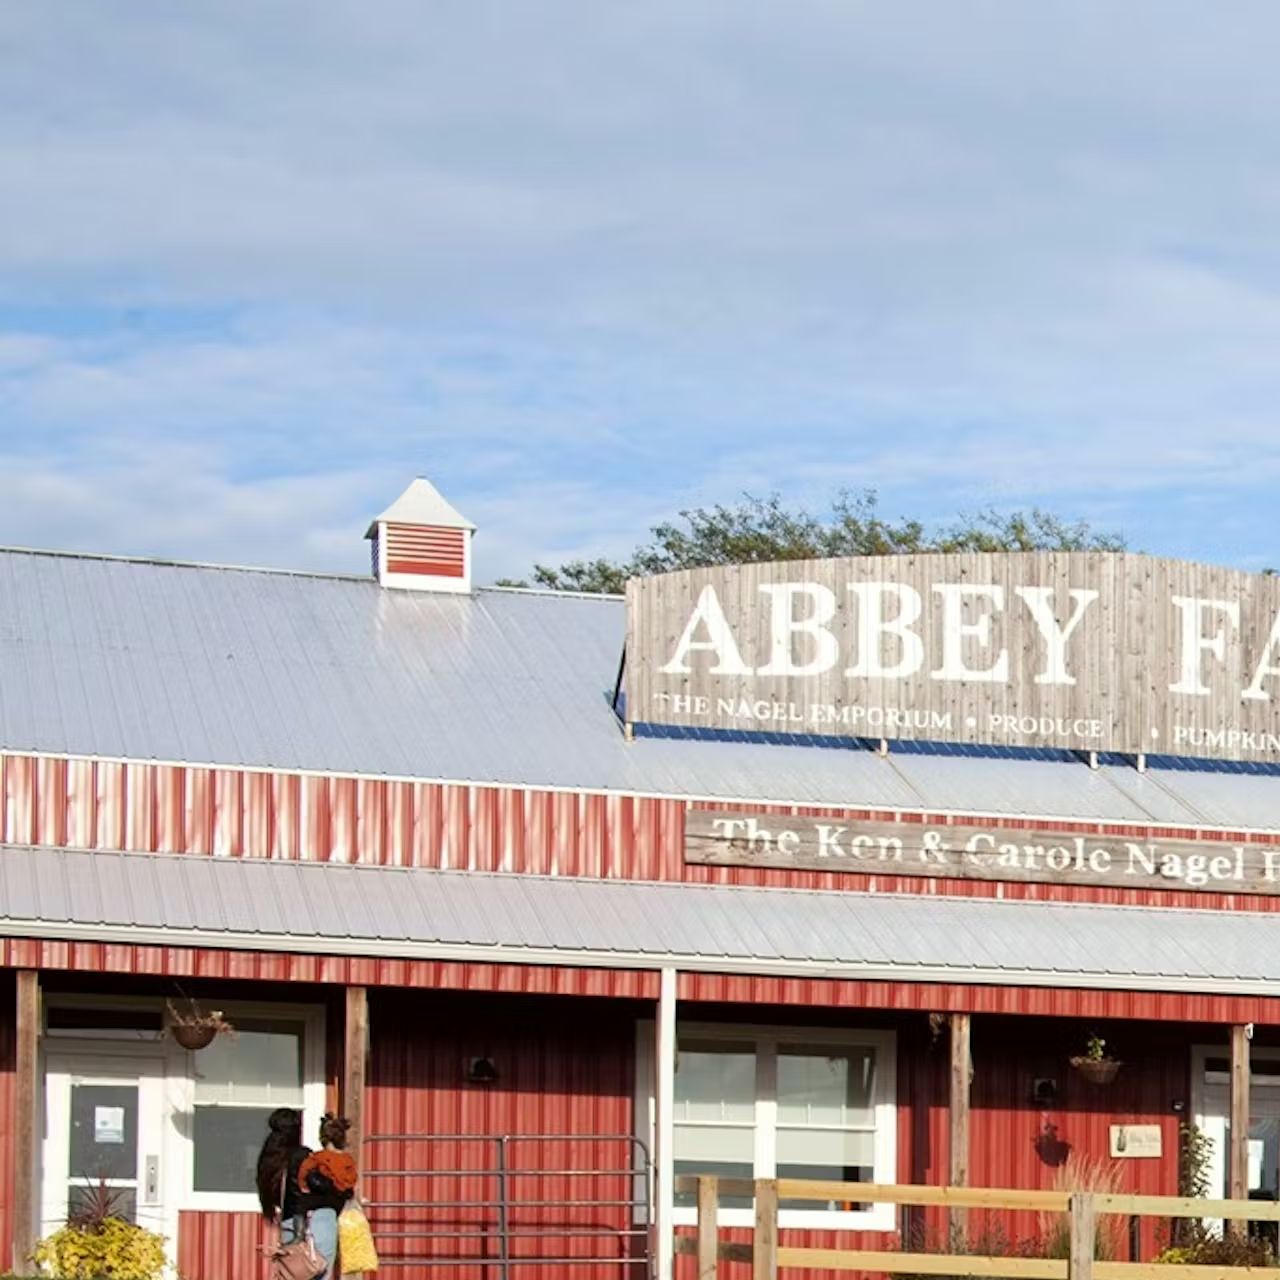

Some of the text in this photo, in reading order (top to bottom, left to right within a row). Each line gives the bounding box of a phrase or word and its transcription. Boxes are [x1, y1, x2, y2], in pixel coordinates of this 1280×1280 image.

[659, 581, 1099, 685] ABBEY
[653, 693, 711, 716] THE
[716, 697, 804, 721] NAGEL
[810, 703, 952, 730] EMPORIUM
[988, 714, 1104, 738] PRODUCE
[711, 817, 801, 856] The
[814, 823, 903, 862] Ken
[919, 830, 952, 864] &
[965, 833, 1112, 872] Carole
[1124, 842, 1245, 886] Nagel
